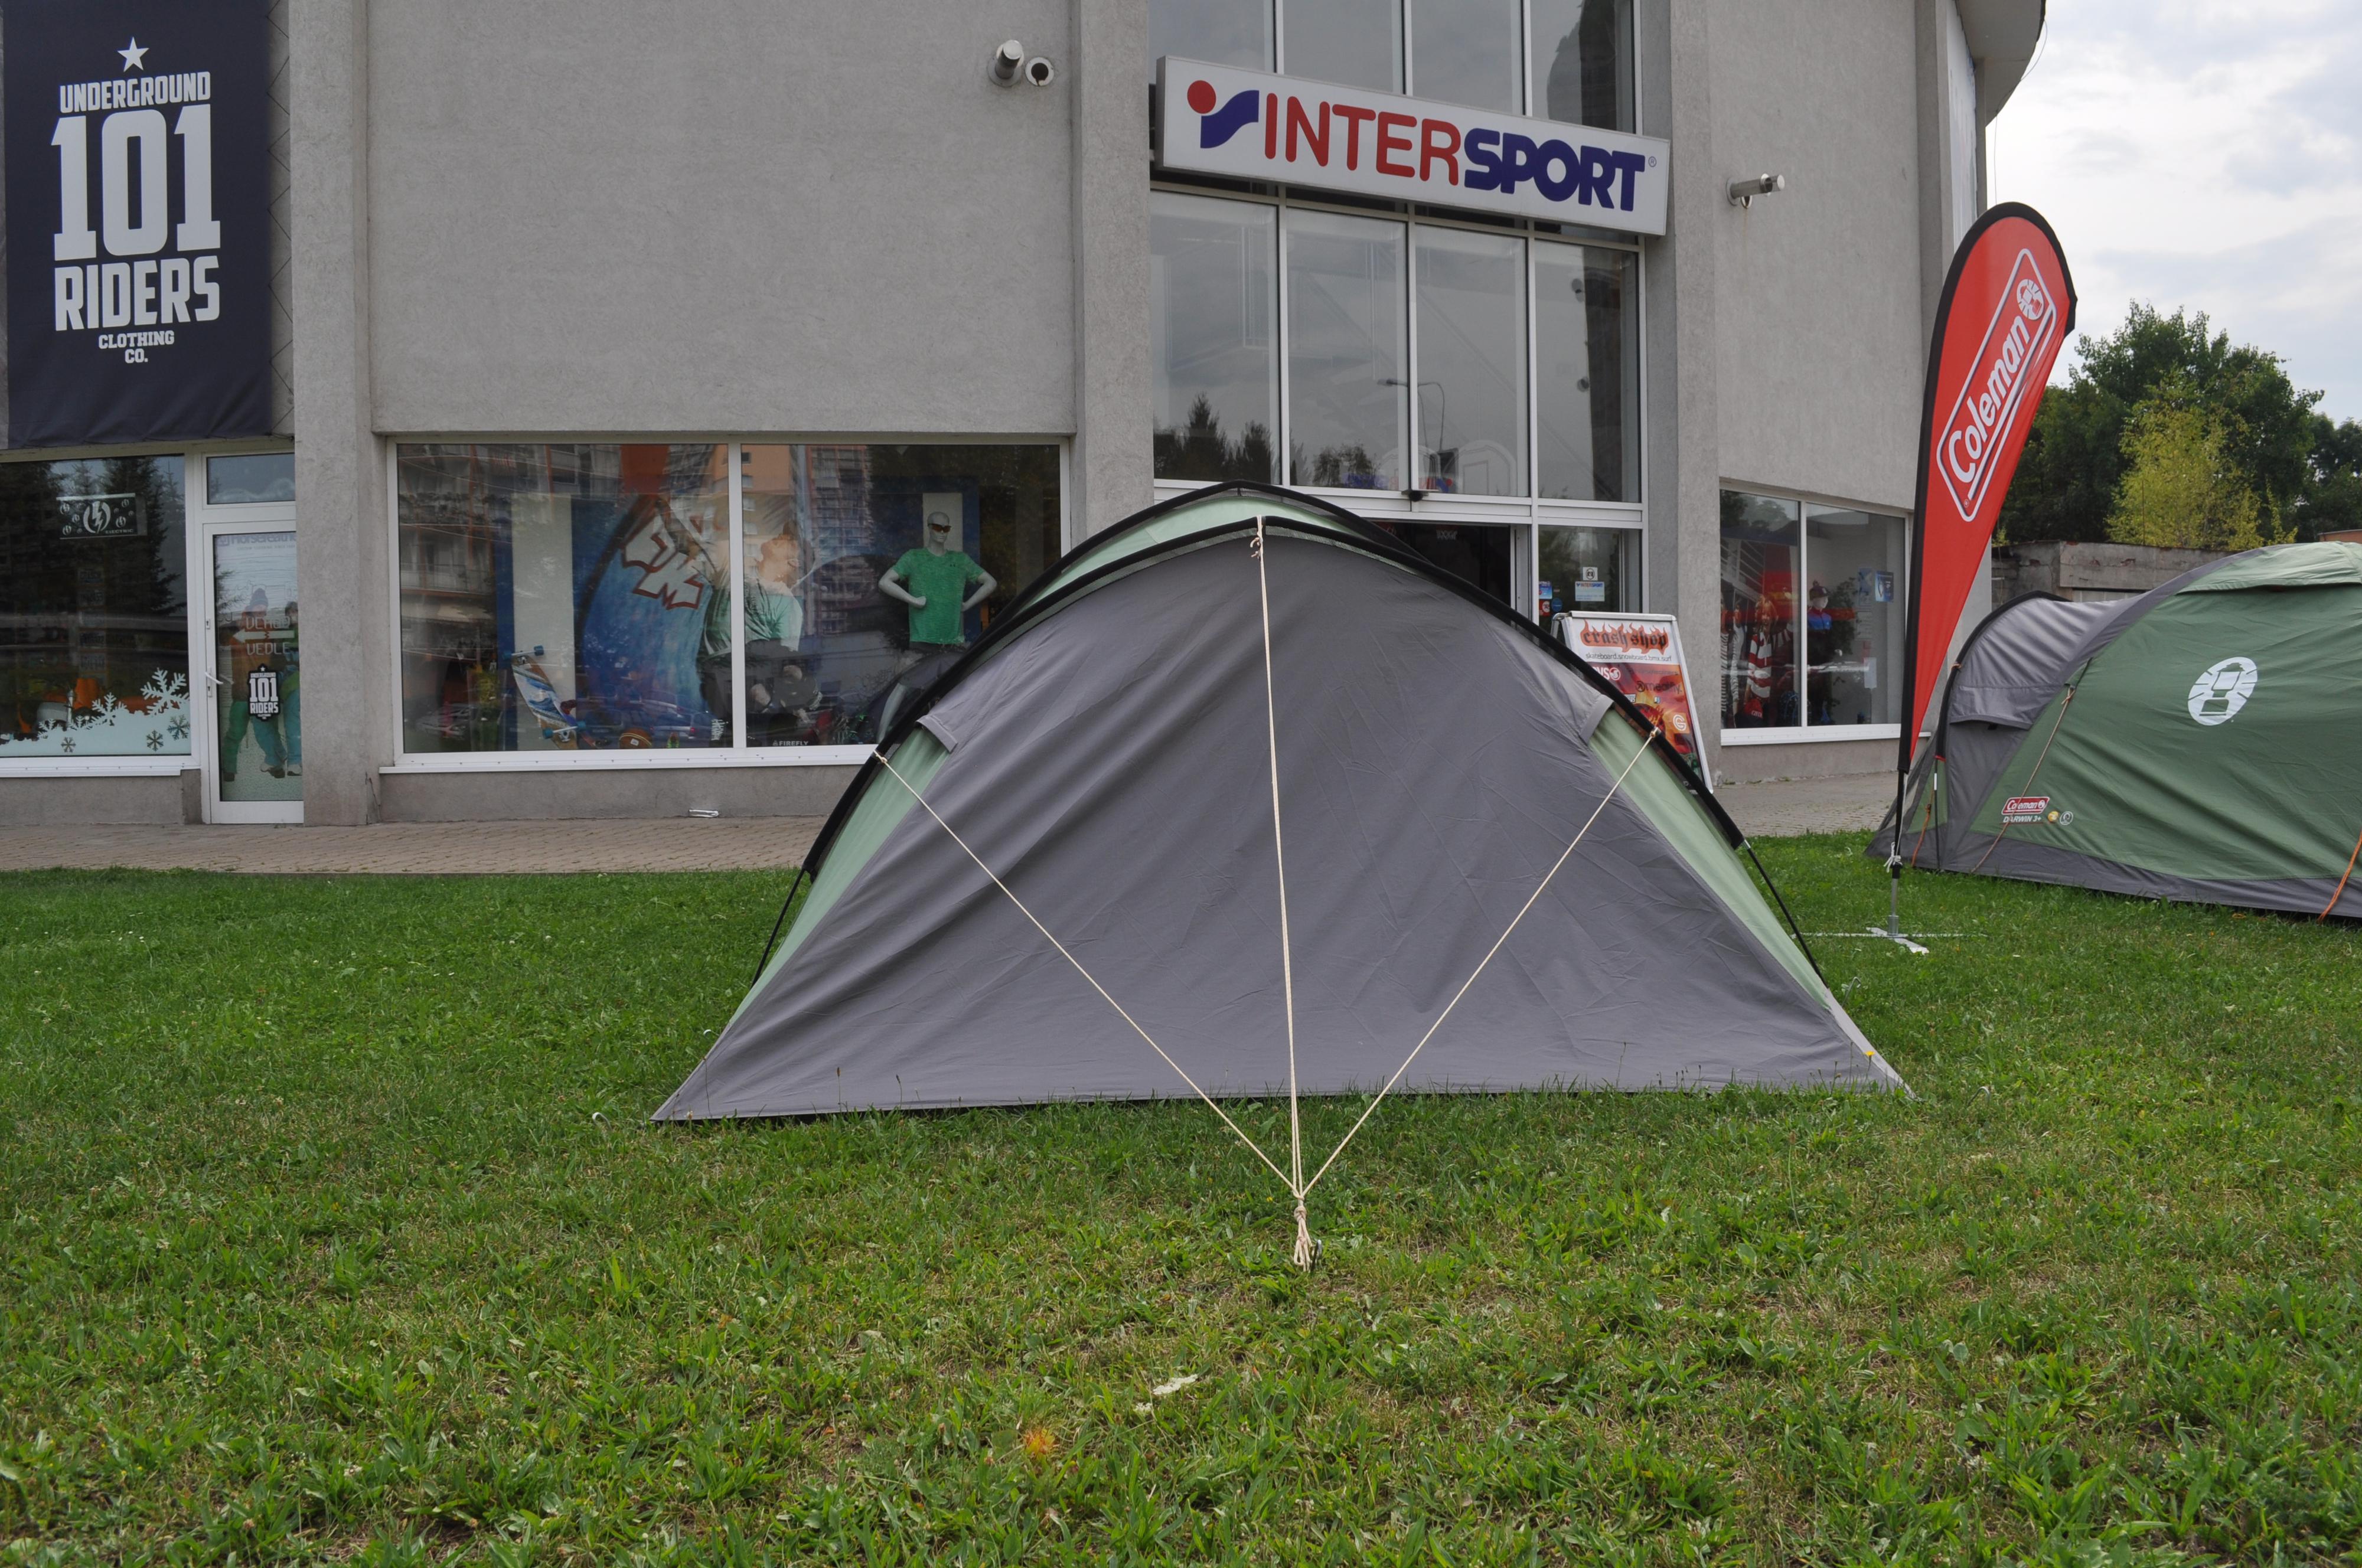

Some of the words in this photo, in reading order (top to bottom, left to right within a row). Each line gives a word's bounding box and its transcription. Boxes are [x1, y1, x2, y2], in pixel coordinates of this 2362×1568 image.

[60, 71, 211, 113] UNDERGROUND
[1265, 92, 1646, 213] INTERSPORT
[51, 104, 221, 261] 101
[54, 256, 220, 331] RIDERS
[99, 330, 175, 349] CLOTHING
[125, 348, 148, 363] CO.
[1948, 315, 2030, 484] Coleman
[247, 642, 291, 656] VEDLE
[1583, 630, 1627, 649] crash
[1630, 630, 1667, 649] shop
[249, 678, 279, 702] 101
[250, 702, 279, 714] RIDERS
